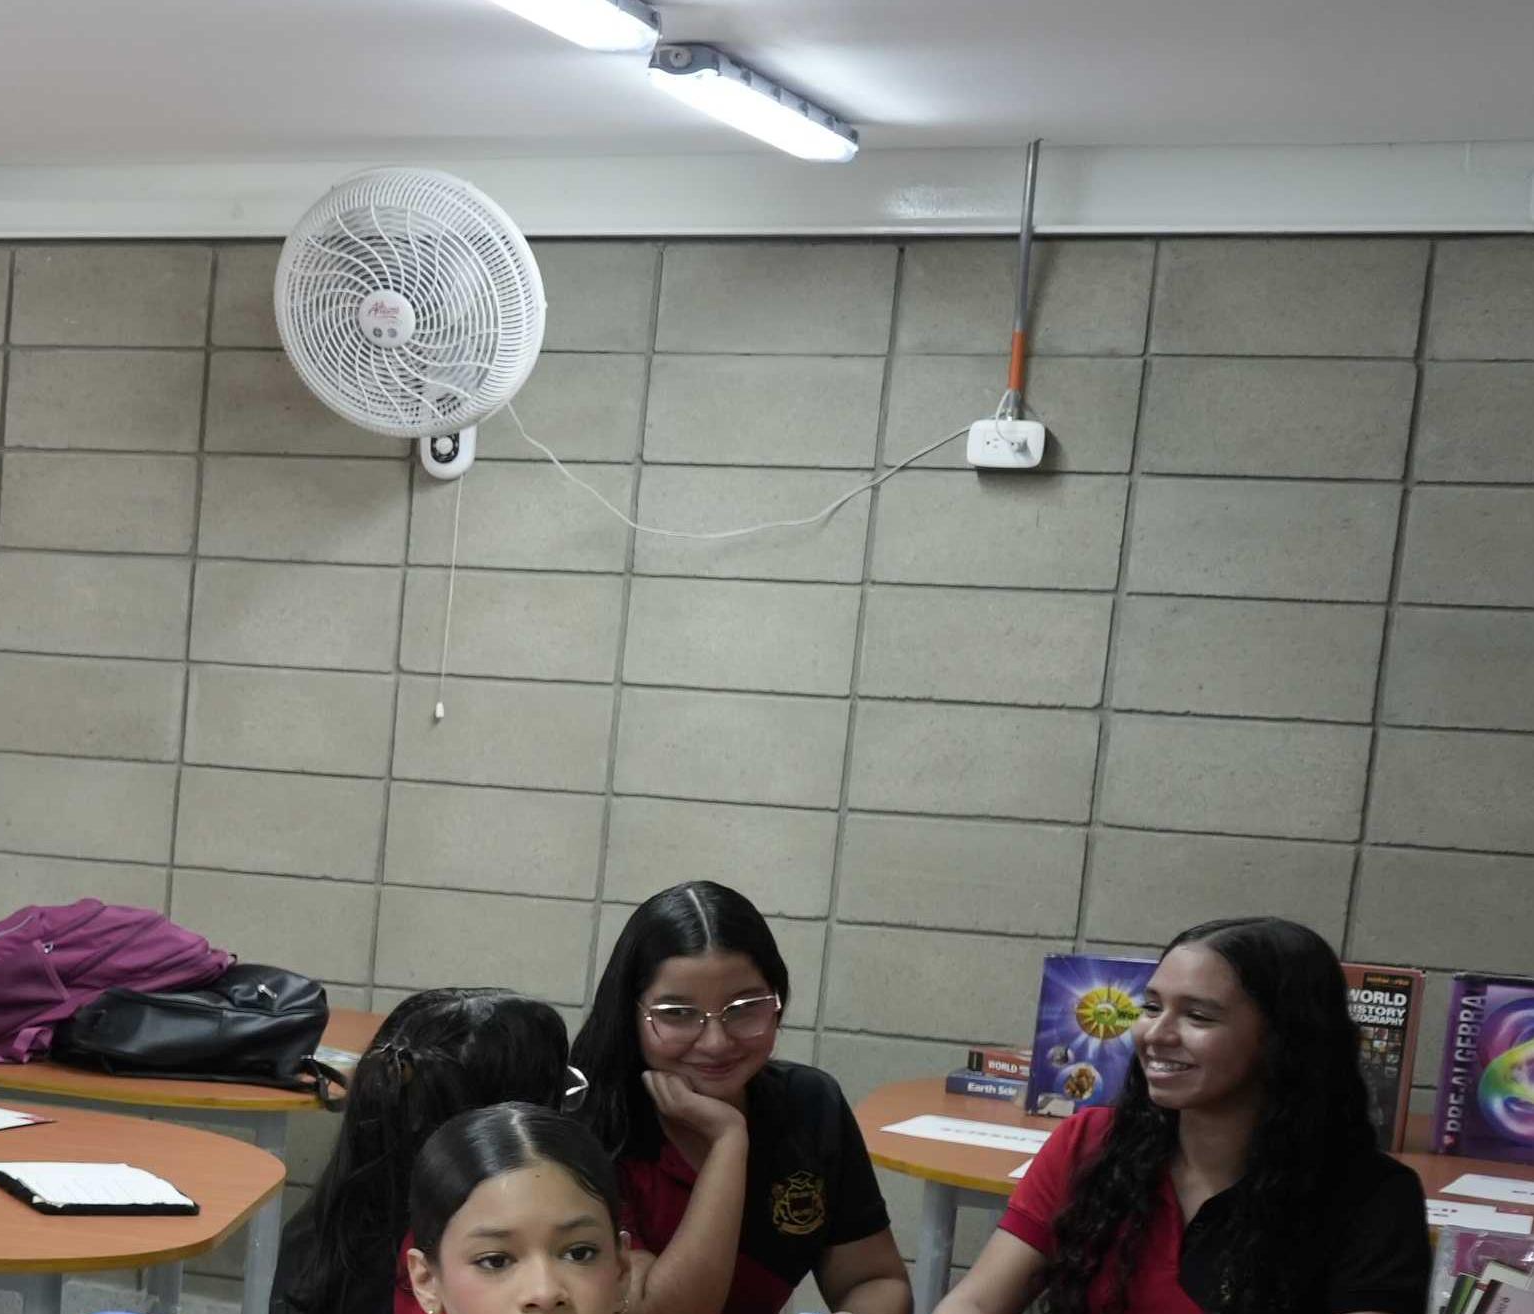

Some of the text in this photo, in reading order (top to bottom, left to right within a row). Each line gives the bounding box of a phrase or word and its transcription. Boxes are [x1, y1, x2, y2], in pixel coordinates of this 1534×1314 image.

[988, 1060, 1018, 1074] WORLD
[1446, 994, 1487, 1132] PRE-ALGEBRA
[967, 1082, 997, 1094] Earth
